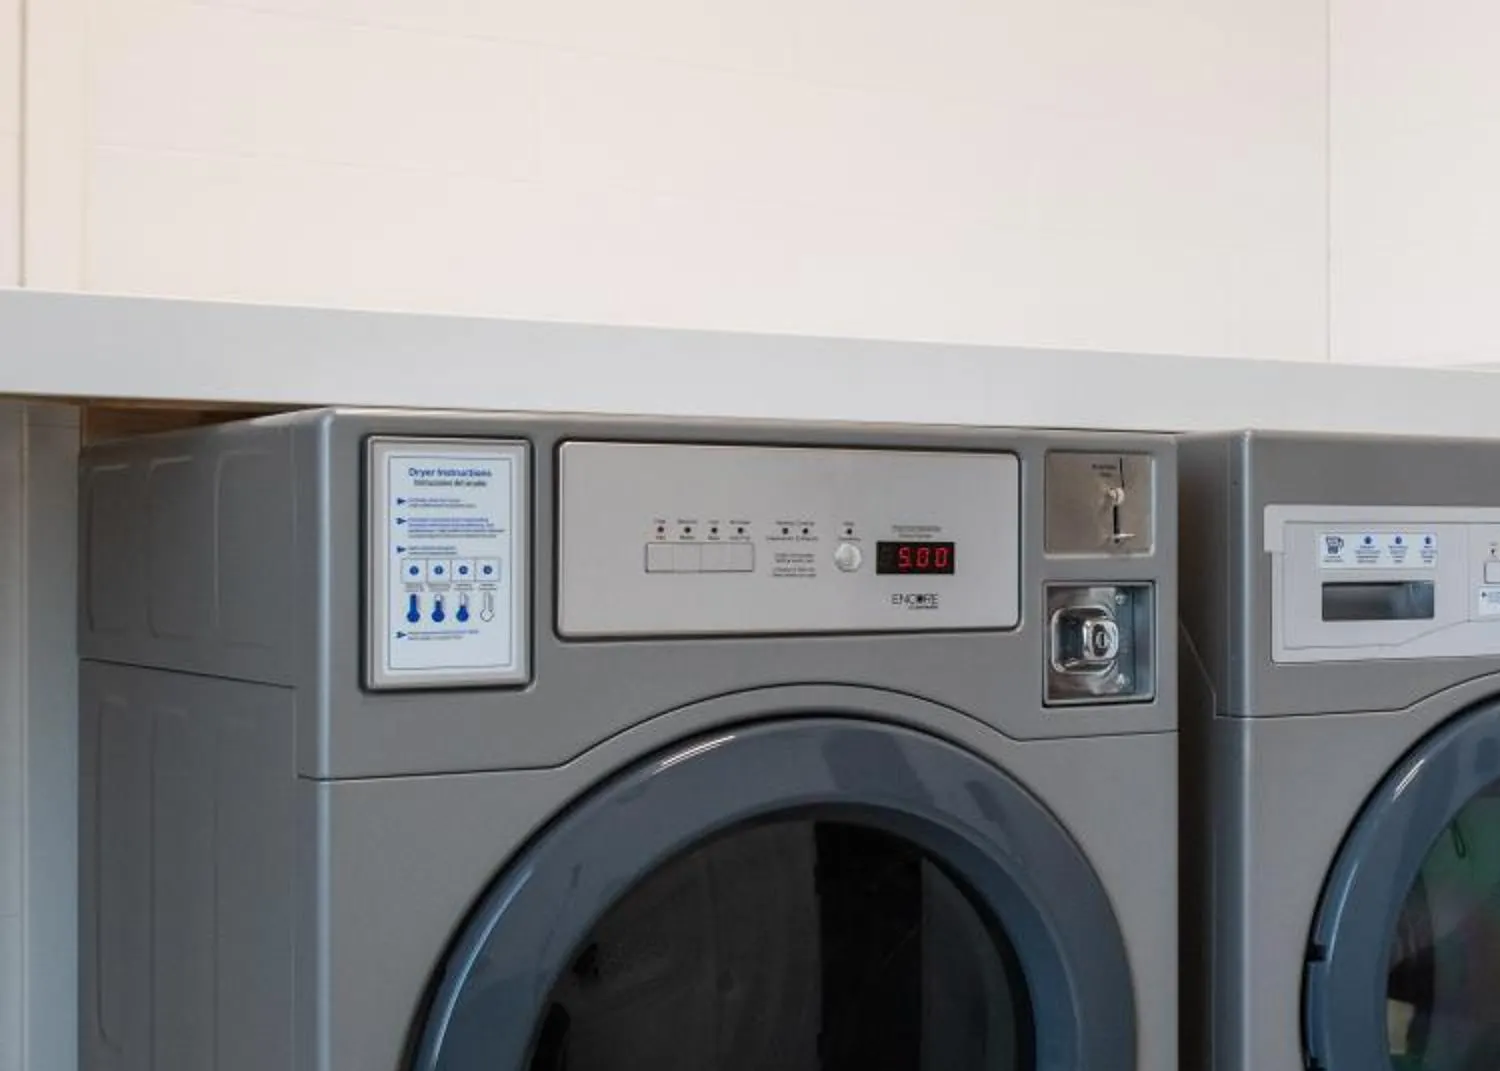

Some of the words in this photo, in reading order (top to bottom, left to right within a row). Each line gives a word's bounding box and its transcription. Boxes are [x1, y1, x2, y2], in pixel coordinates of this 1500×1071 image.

[408, 467, 435, 477] Dryer
[437, 467, 493, 477] Instructions
[891, 593, 939, 605] ENCORE
